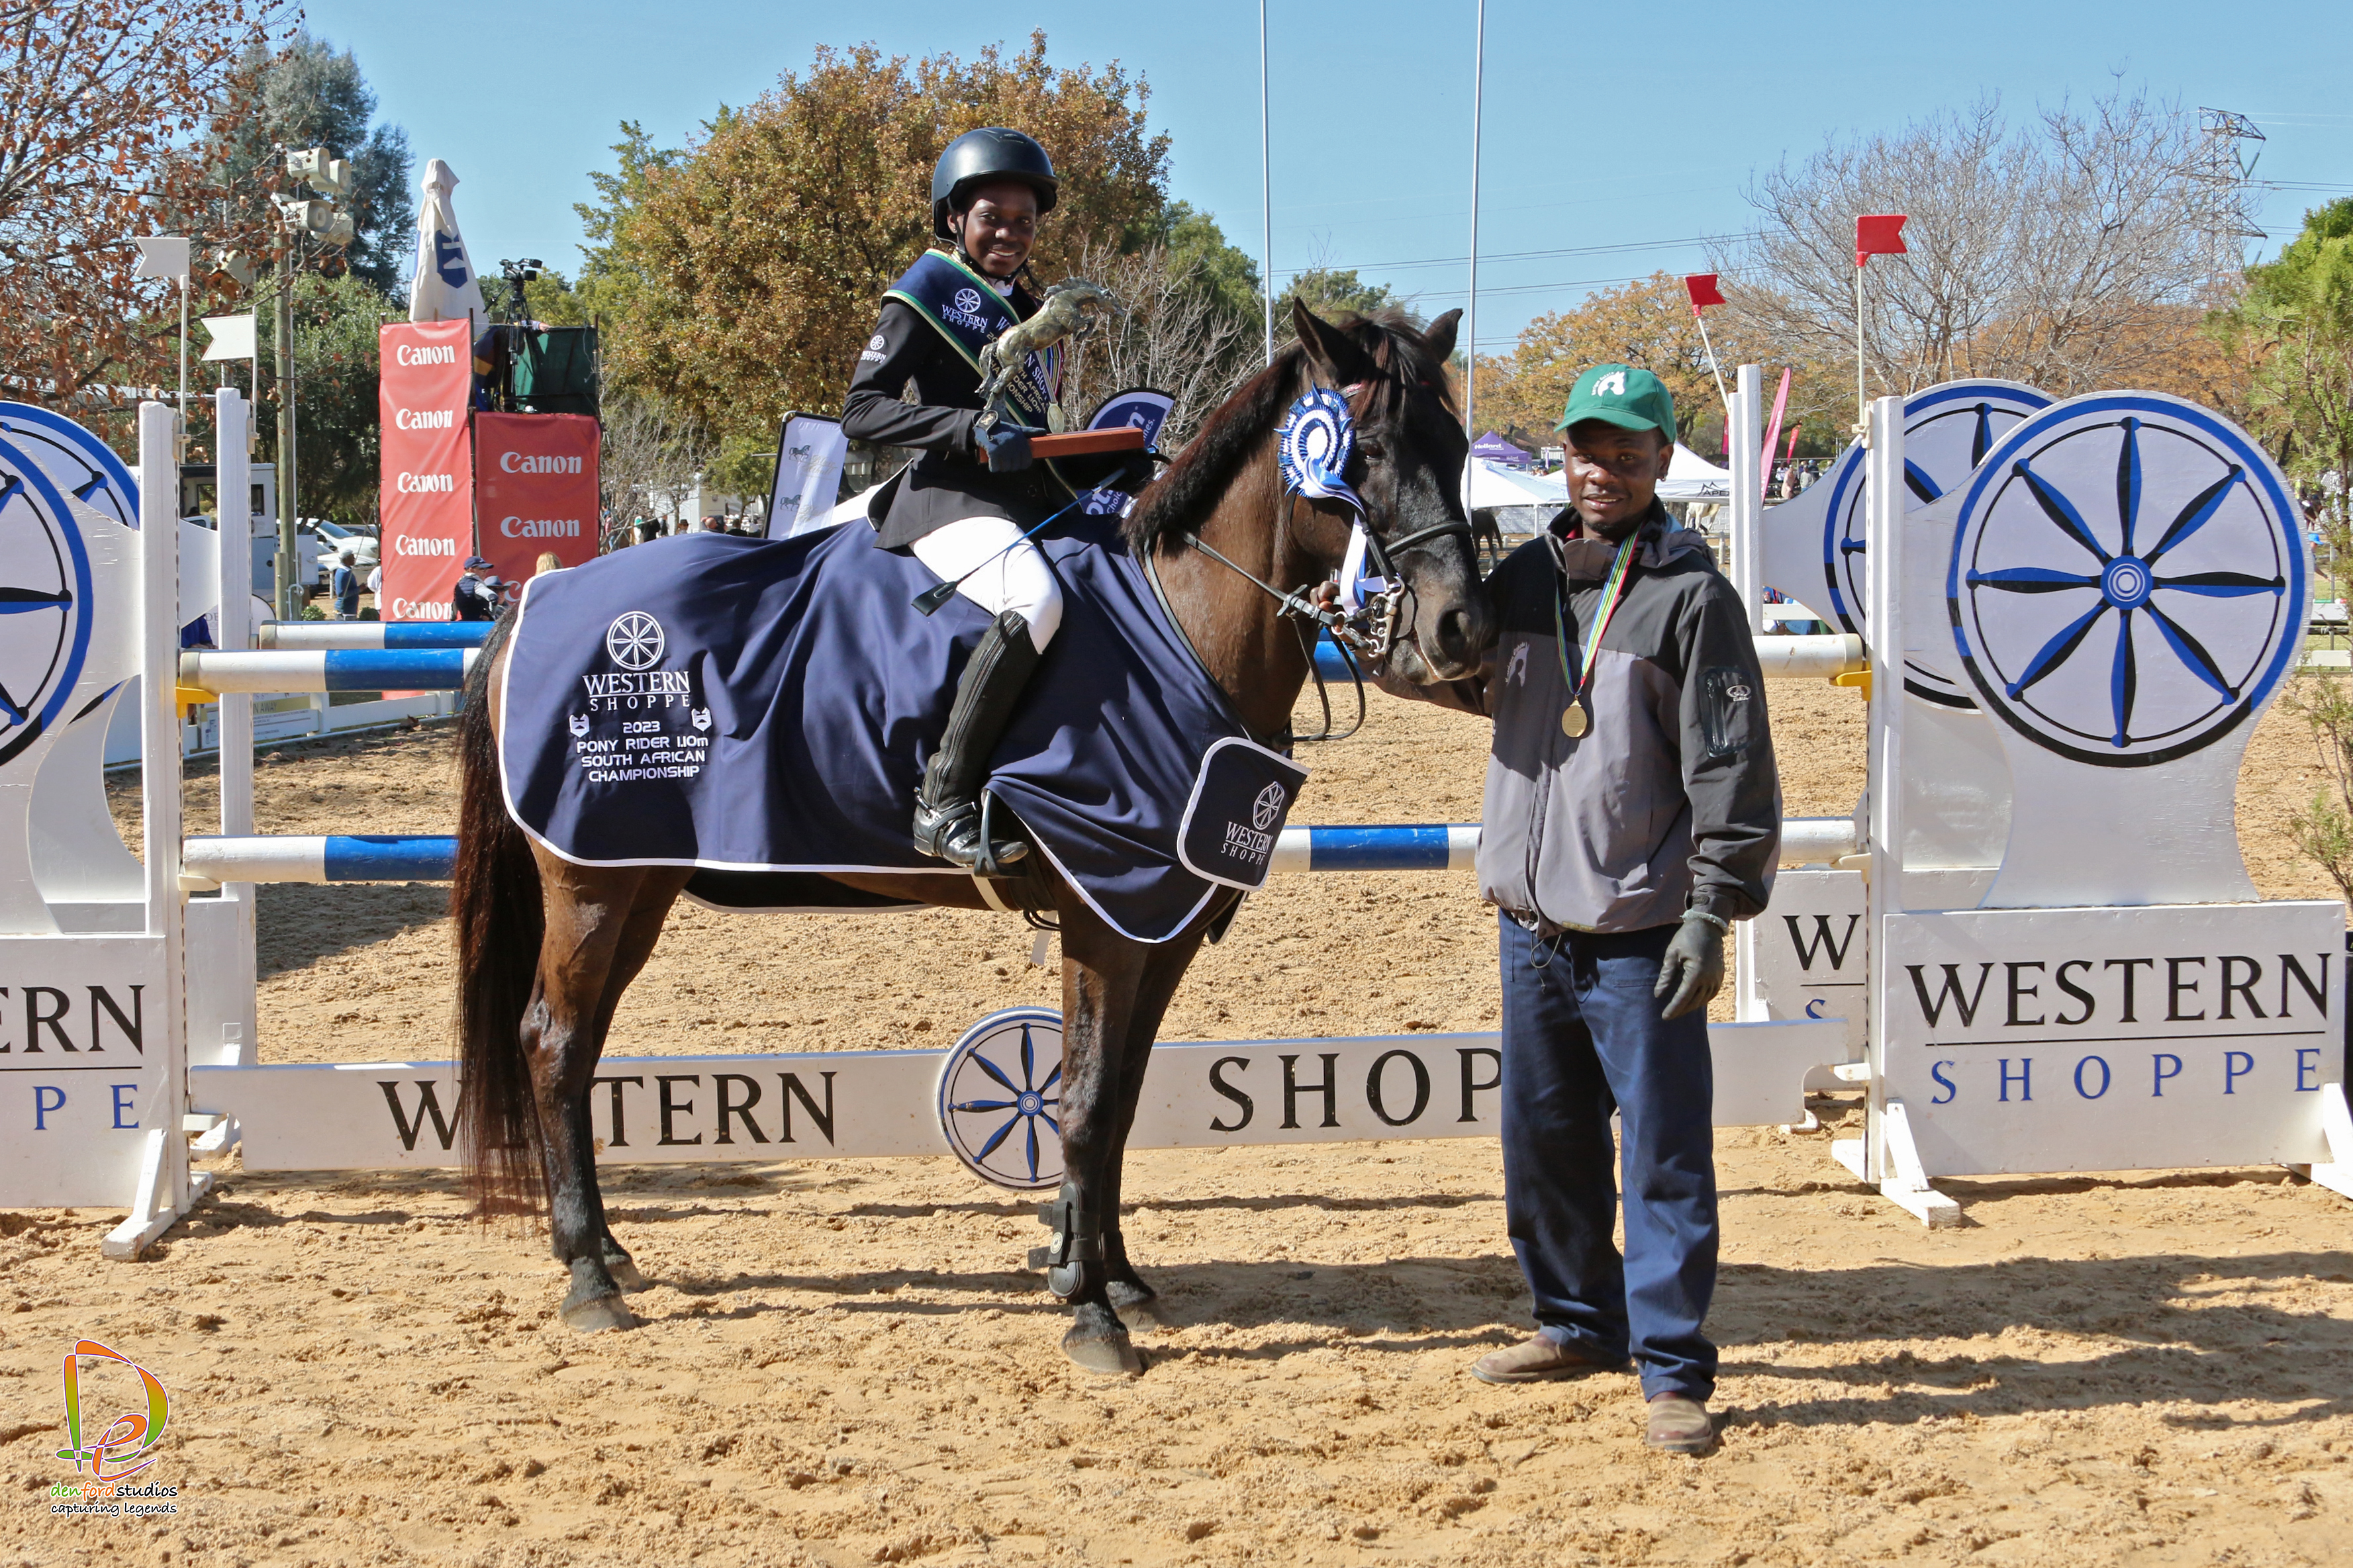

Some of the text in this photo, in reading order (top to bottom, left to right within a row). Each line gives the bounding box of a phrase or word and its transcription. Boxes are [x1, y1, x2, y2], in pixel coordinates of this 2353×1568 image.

[941, 304, 988, 328] WESTERN
[942, 313, 985, 334] SHOPPE
[397, 344, 456, 366] Canon
[396, 408, 453, 430] Canon
[500, 451, 582, 474] Canon
[397, 471, 453, 493] Canon
[501, 516, 581, 538] Canon
[395, 534, 456, 556] Canon
[393, 597, 452, 620] Canon
[582, 671, 691, 695] WESTERN
[591, 694, 690, 712] SHOPPE
[623, 721, 661, 733] 2023
[577, 735, 708, 753] PONY RIDER 1.10m
[582, 751, 705, 768] SOUTH AFRICAN
[589, 766, 700, 782] CHAMPIONSHIP
[1225, 821, 1274, 853] WESTERN
[1904, 953, 2332, 1029] WESTERN
[1931, 1048, 2321, 1105] SHOPPE
[377, 1048, 1502, 1151] WTERN SHOP
